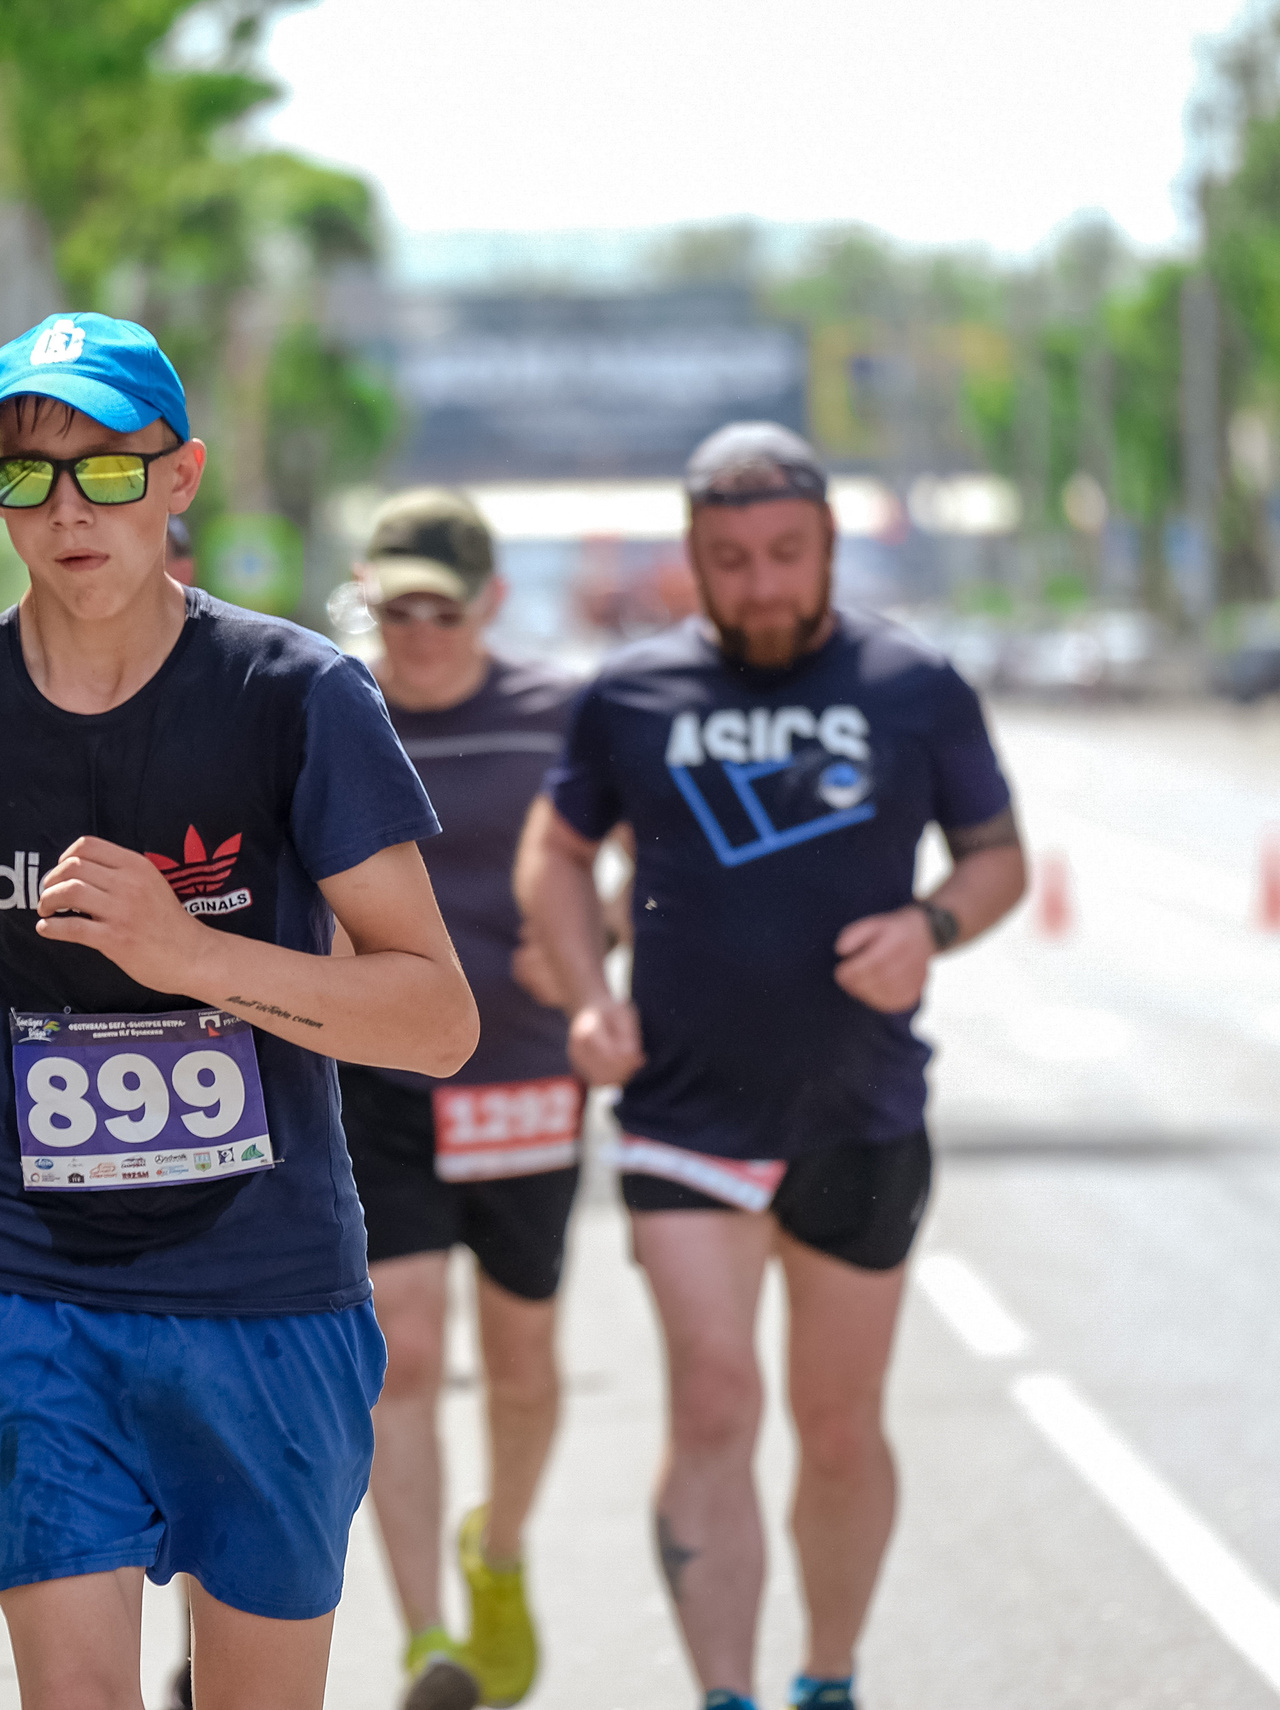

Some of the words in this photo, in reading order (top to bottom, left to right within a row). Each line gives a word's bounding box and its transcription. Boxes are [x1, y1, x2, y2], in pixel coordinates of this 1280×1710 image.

[665, 705, 870, 767] ASICS
[184, 893, 248, 913] GINALS
[109, 1021, 126, 1030] БЕГА
[223, 1017, 241, 1027] РУСА
[27, 1050, 245, 1148] 899
